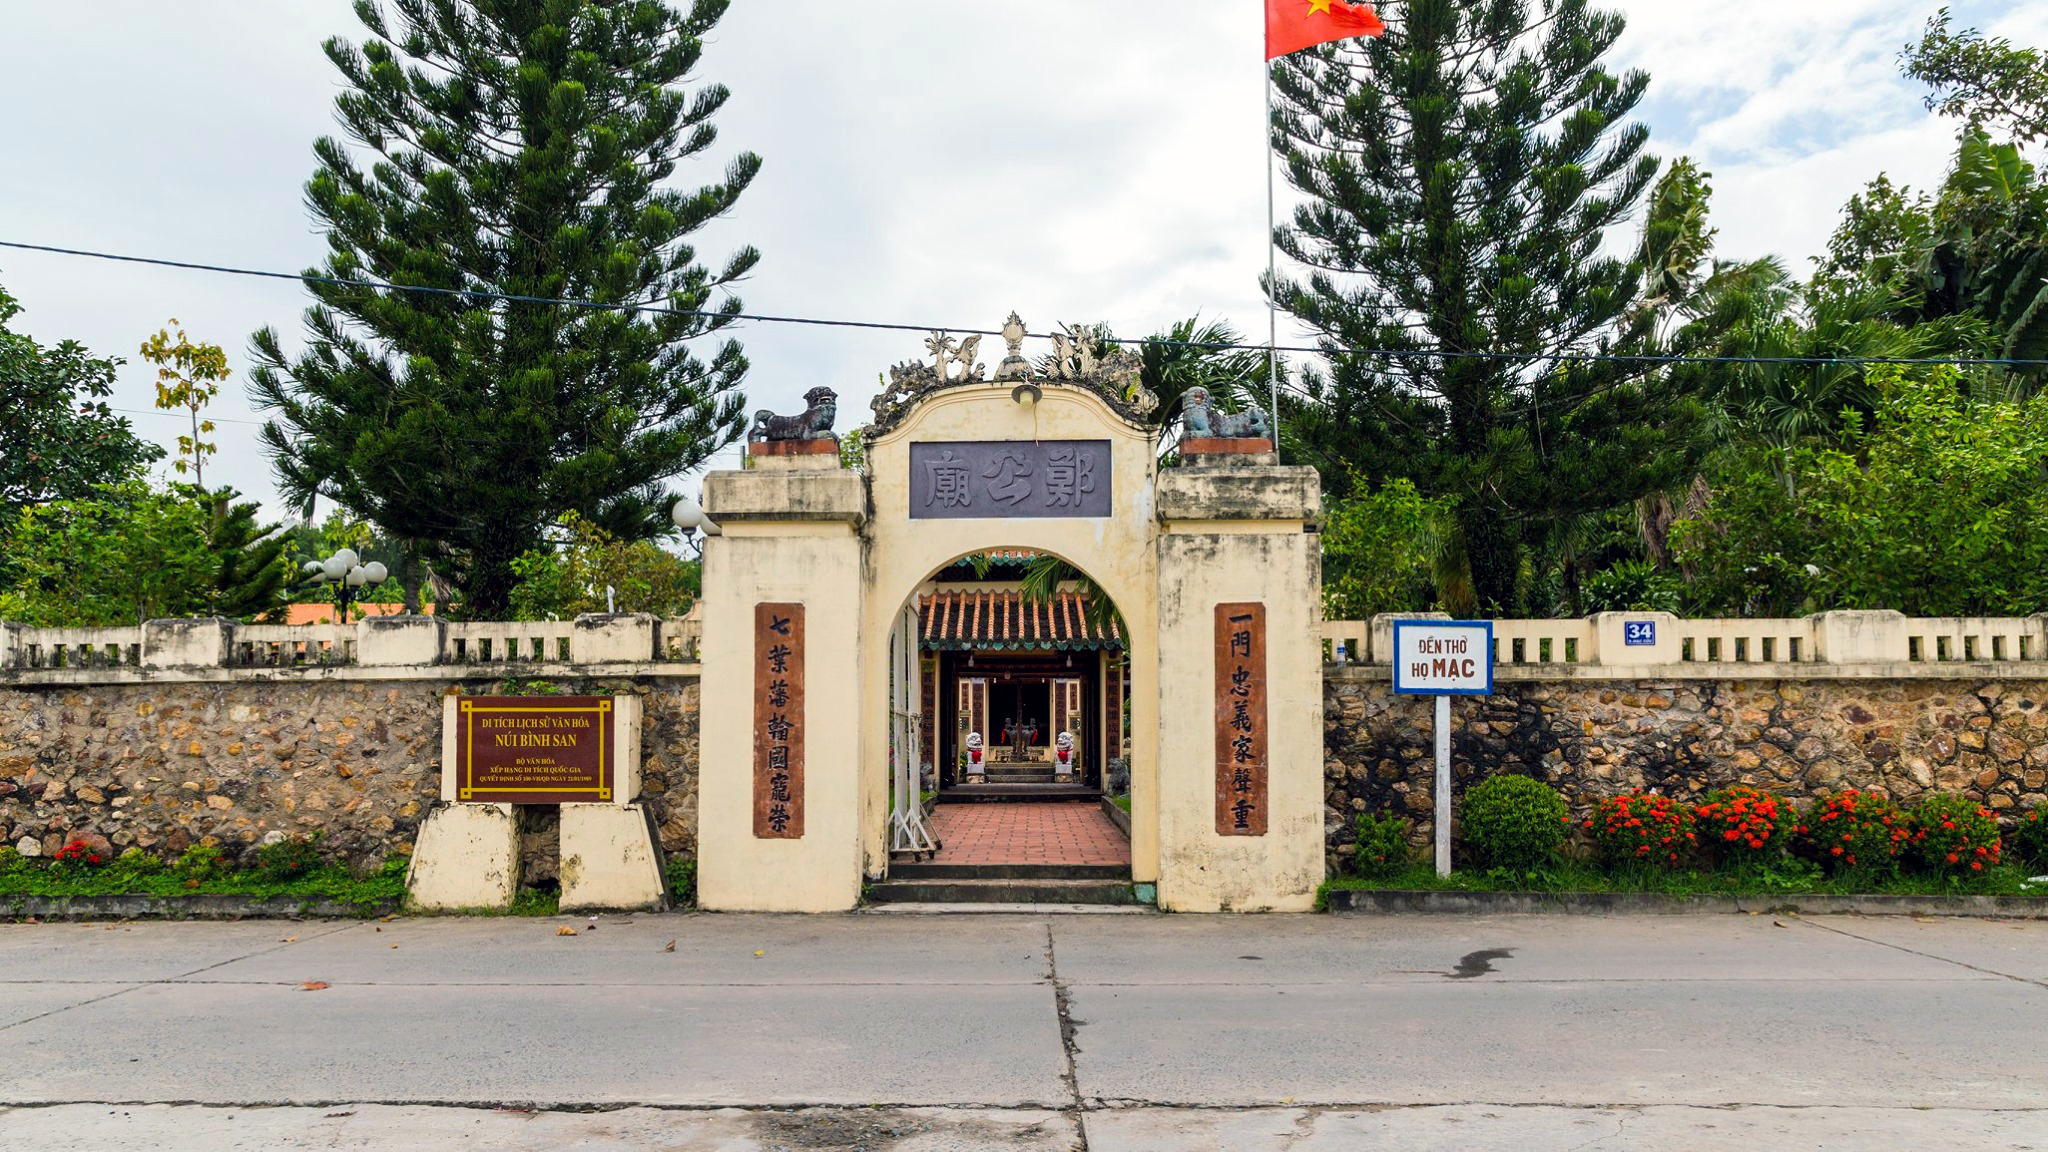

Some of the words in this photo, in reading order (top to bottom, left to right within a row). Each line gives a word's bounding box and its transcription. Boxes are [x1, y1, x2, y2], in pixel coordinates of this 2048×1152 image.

[1629, 624, 1652, 639] 34
[1412, 662, 1429, 681] HỌ
[1433, 658, 1475, 681] MẠC
[482, 718, 492, 728] DI
[494, 716, 515, 728] TÍCH
[517, 718, 538, 730] LỊCH
[539, 715, 551, 728] SỬ
[552, 716, 571, 728] VĂN
[572, 715, 590, 728] HÓA
[1228, 614, 1256, 829] 一門忠義家聲重
[495, 731, 517, 747] NÚI
[520, 730, 550, 747] BÌNH
[553, 734, 577, 747] SAN
[550, 765, 569, 774] QUỐC
